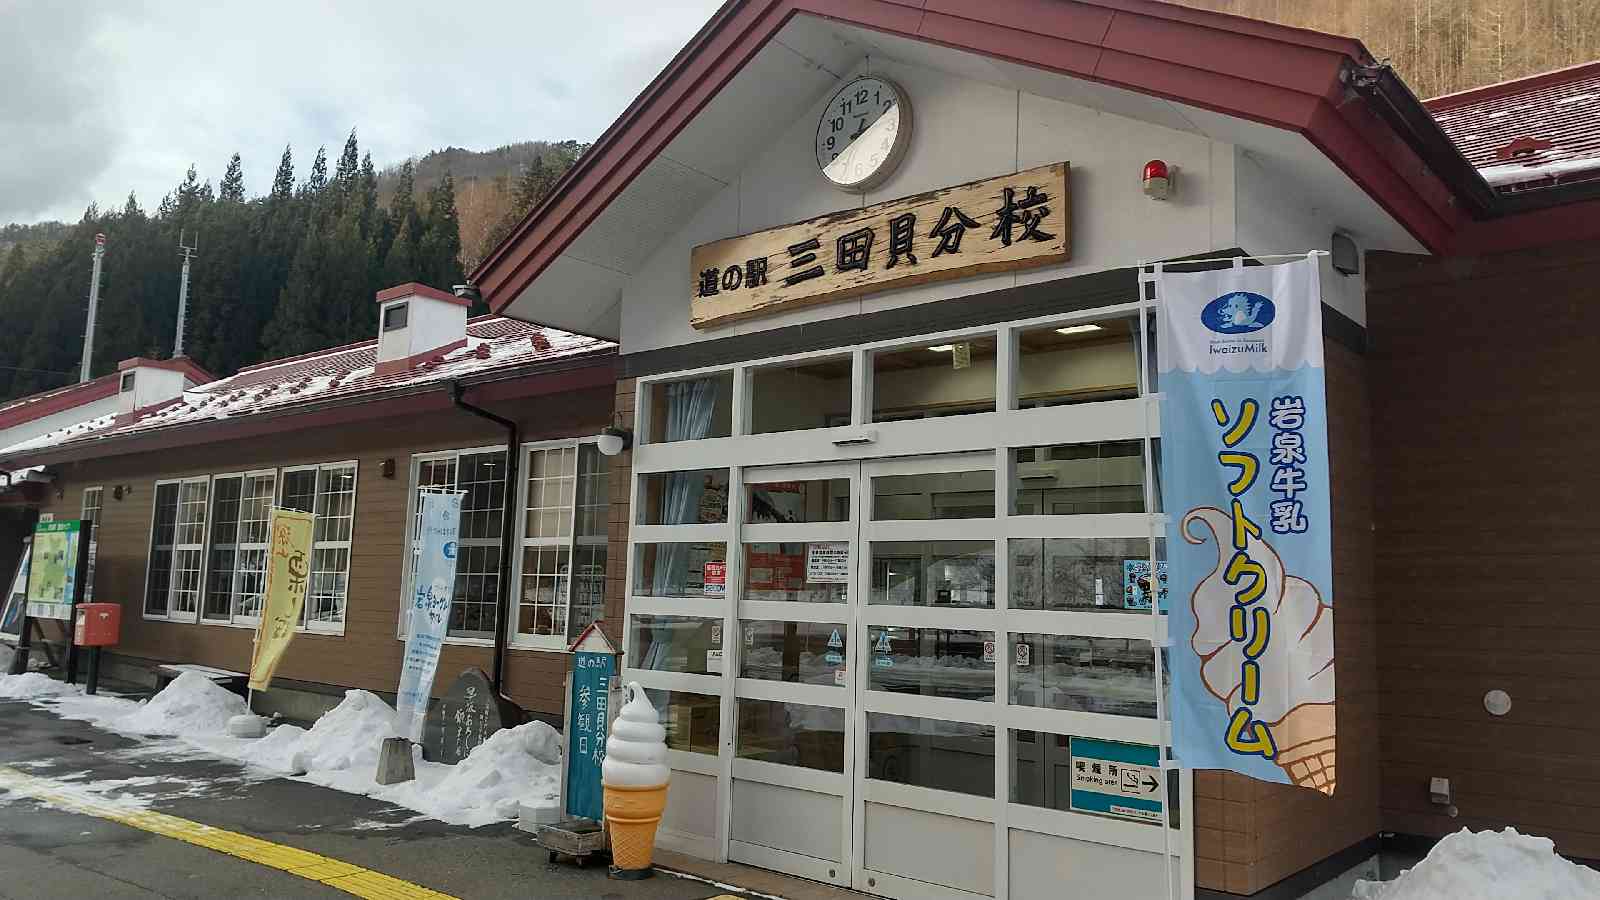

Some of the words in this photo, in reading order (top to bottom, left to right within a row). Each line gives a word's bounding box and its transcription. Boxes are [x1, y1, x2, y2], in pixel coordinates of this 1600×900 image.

[854, 89, 869, 105] 12
[874, 90, 880, 105] 1
[840, 100, 852, 115] 11
[882, 99, 892, 115] 2
[830, 117, 844, 133] 10
[886, 118, 895, 132] 3
[826, 136, 836, 151] 9
[871, 153, 880, 167] 5
[855, 163, 864, 176] 6
[698, 256, 768, 297] 道の駅
[781, 186, 1056, 287] 三田貝分校
[1270, 396, 1310, 535] 岩泉牛乳
[1211, 398, 1279, 760] ソフトクリーム
[577, 655, 607, 668] 道の駅
[577, 685, 592, 754] 参観日
[592, 677, 609, 768] 三田貝分校
[1075, 761, 1118, 776] 喫煙所
[1076, 774, 1103, 786] Smoking
